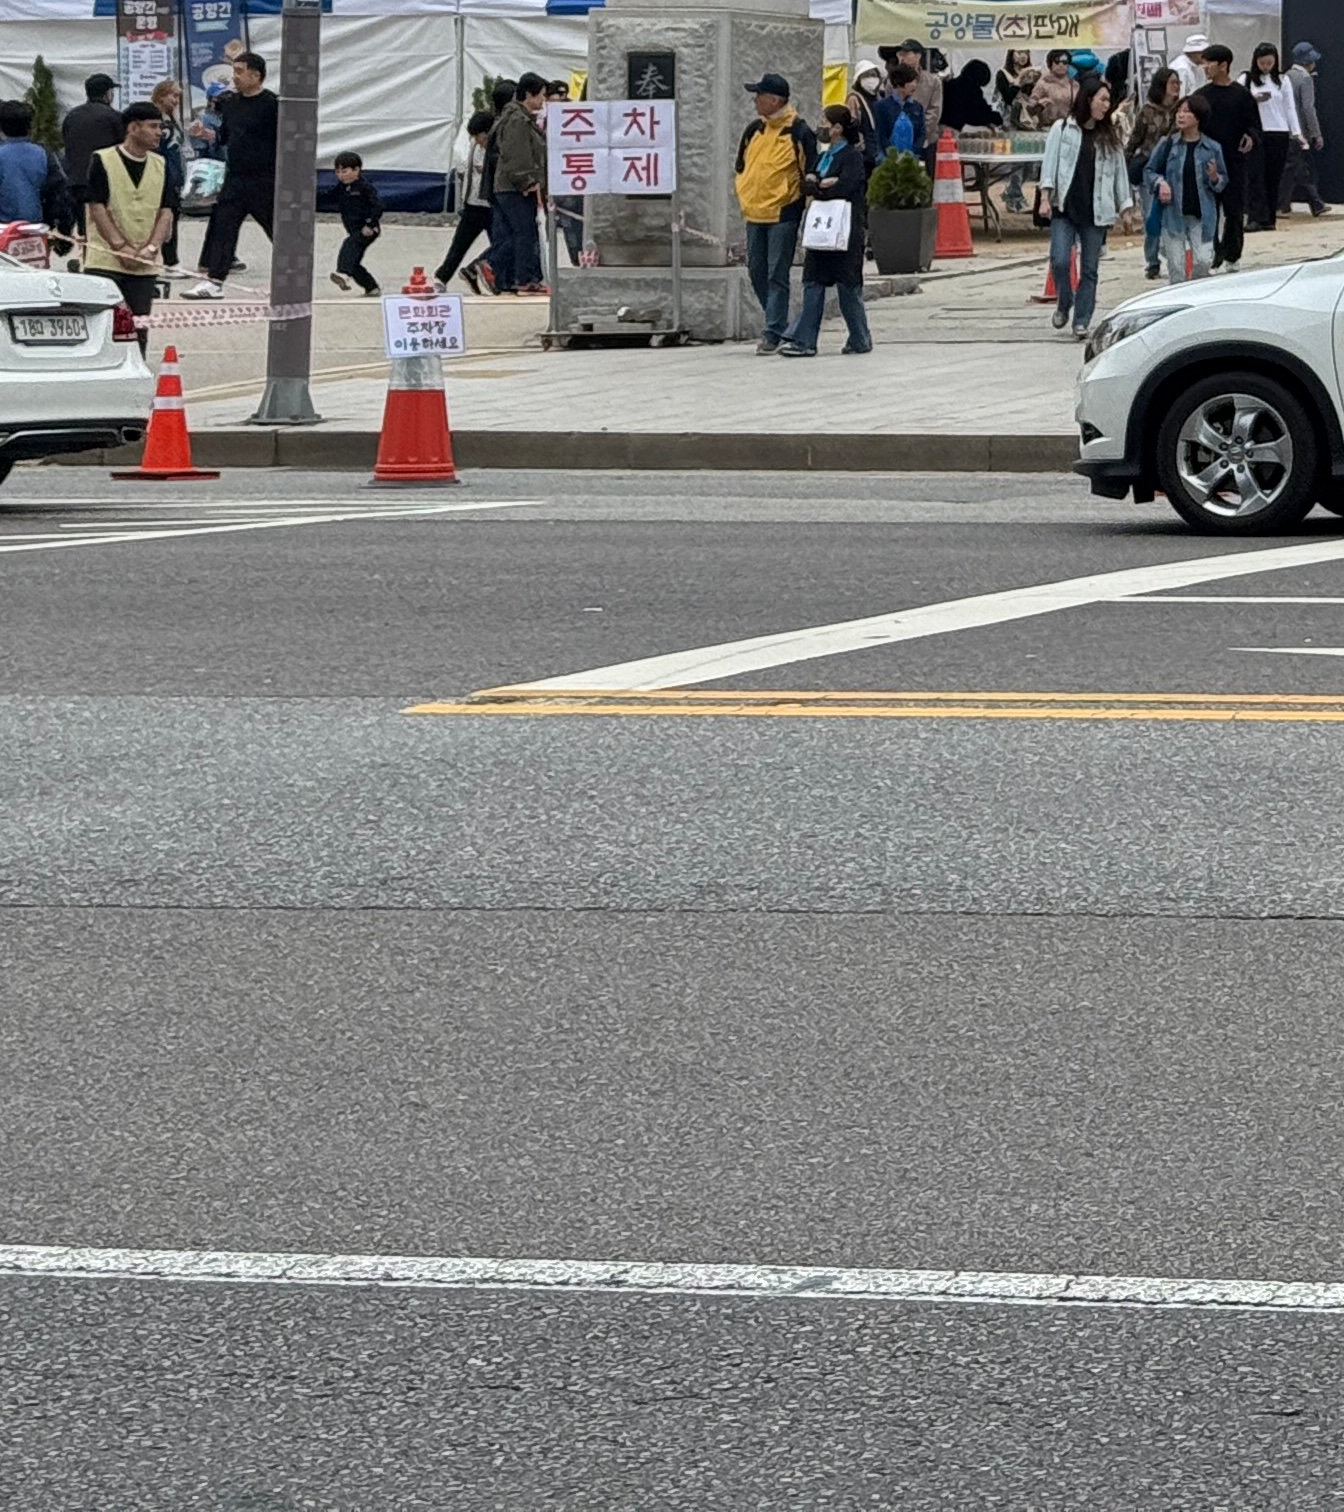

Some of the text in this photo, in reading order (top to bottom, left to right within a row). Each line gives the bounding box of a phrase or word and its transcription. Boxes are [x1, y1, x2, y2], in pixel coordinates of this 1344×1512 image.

[925, 11, 1080, 41] 공양물(초)판매
[560, 106, 661, 142] 주차
[561, 152, 660, 191] 통제
[398, 304, 452, 320] 문화회관
[48, 318, 81, 337] 3960
[406, 320, 447, 335] 주차장
[394, 336, 459, 352] 이용하세요
